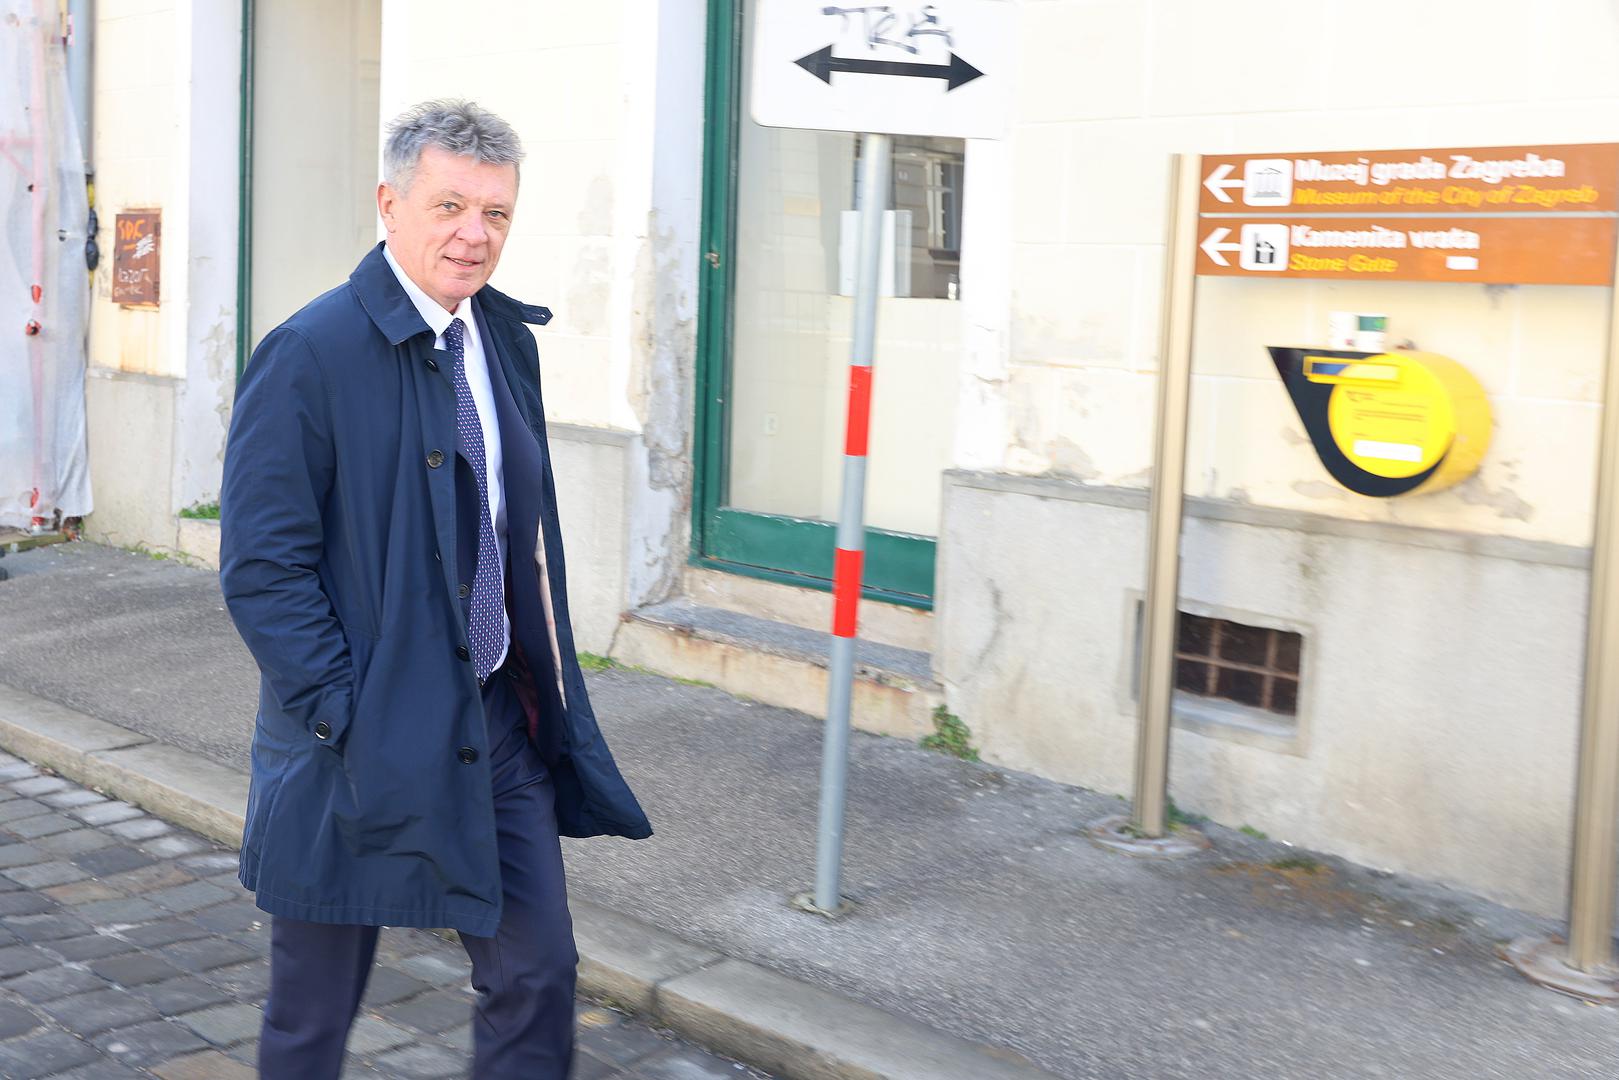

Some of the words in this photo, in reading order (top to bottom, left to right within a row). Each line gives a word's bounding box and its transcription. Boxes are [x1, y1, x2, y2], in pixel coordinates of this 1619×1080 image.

[1294, 157, 1369, 185] Muzej
[1370, 156, 1446, 184] grada
[1449, 153, 1565, 183] Zagreba
[1293, 188, 1378, 204] Museum
[1403, 187, 1440, 203] the
[1441, 186, 1482, 207] City
[1512, 184, 1599, 207] Zagreb
[1290, 225, 1407, 249] Kamenita
[1408, 227, 1480, 249] vrata
[1289, 253, 1347, 272] Stone
[1347, 254, 1398, 273] Gate
